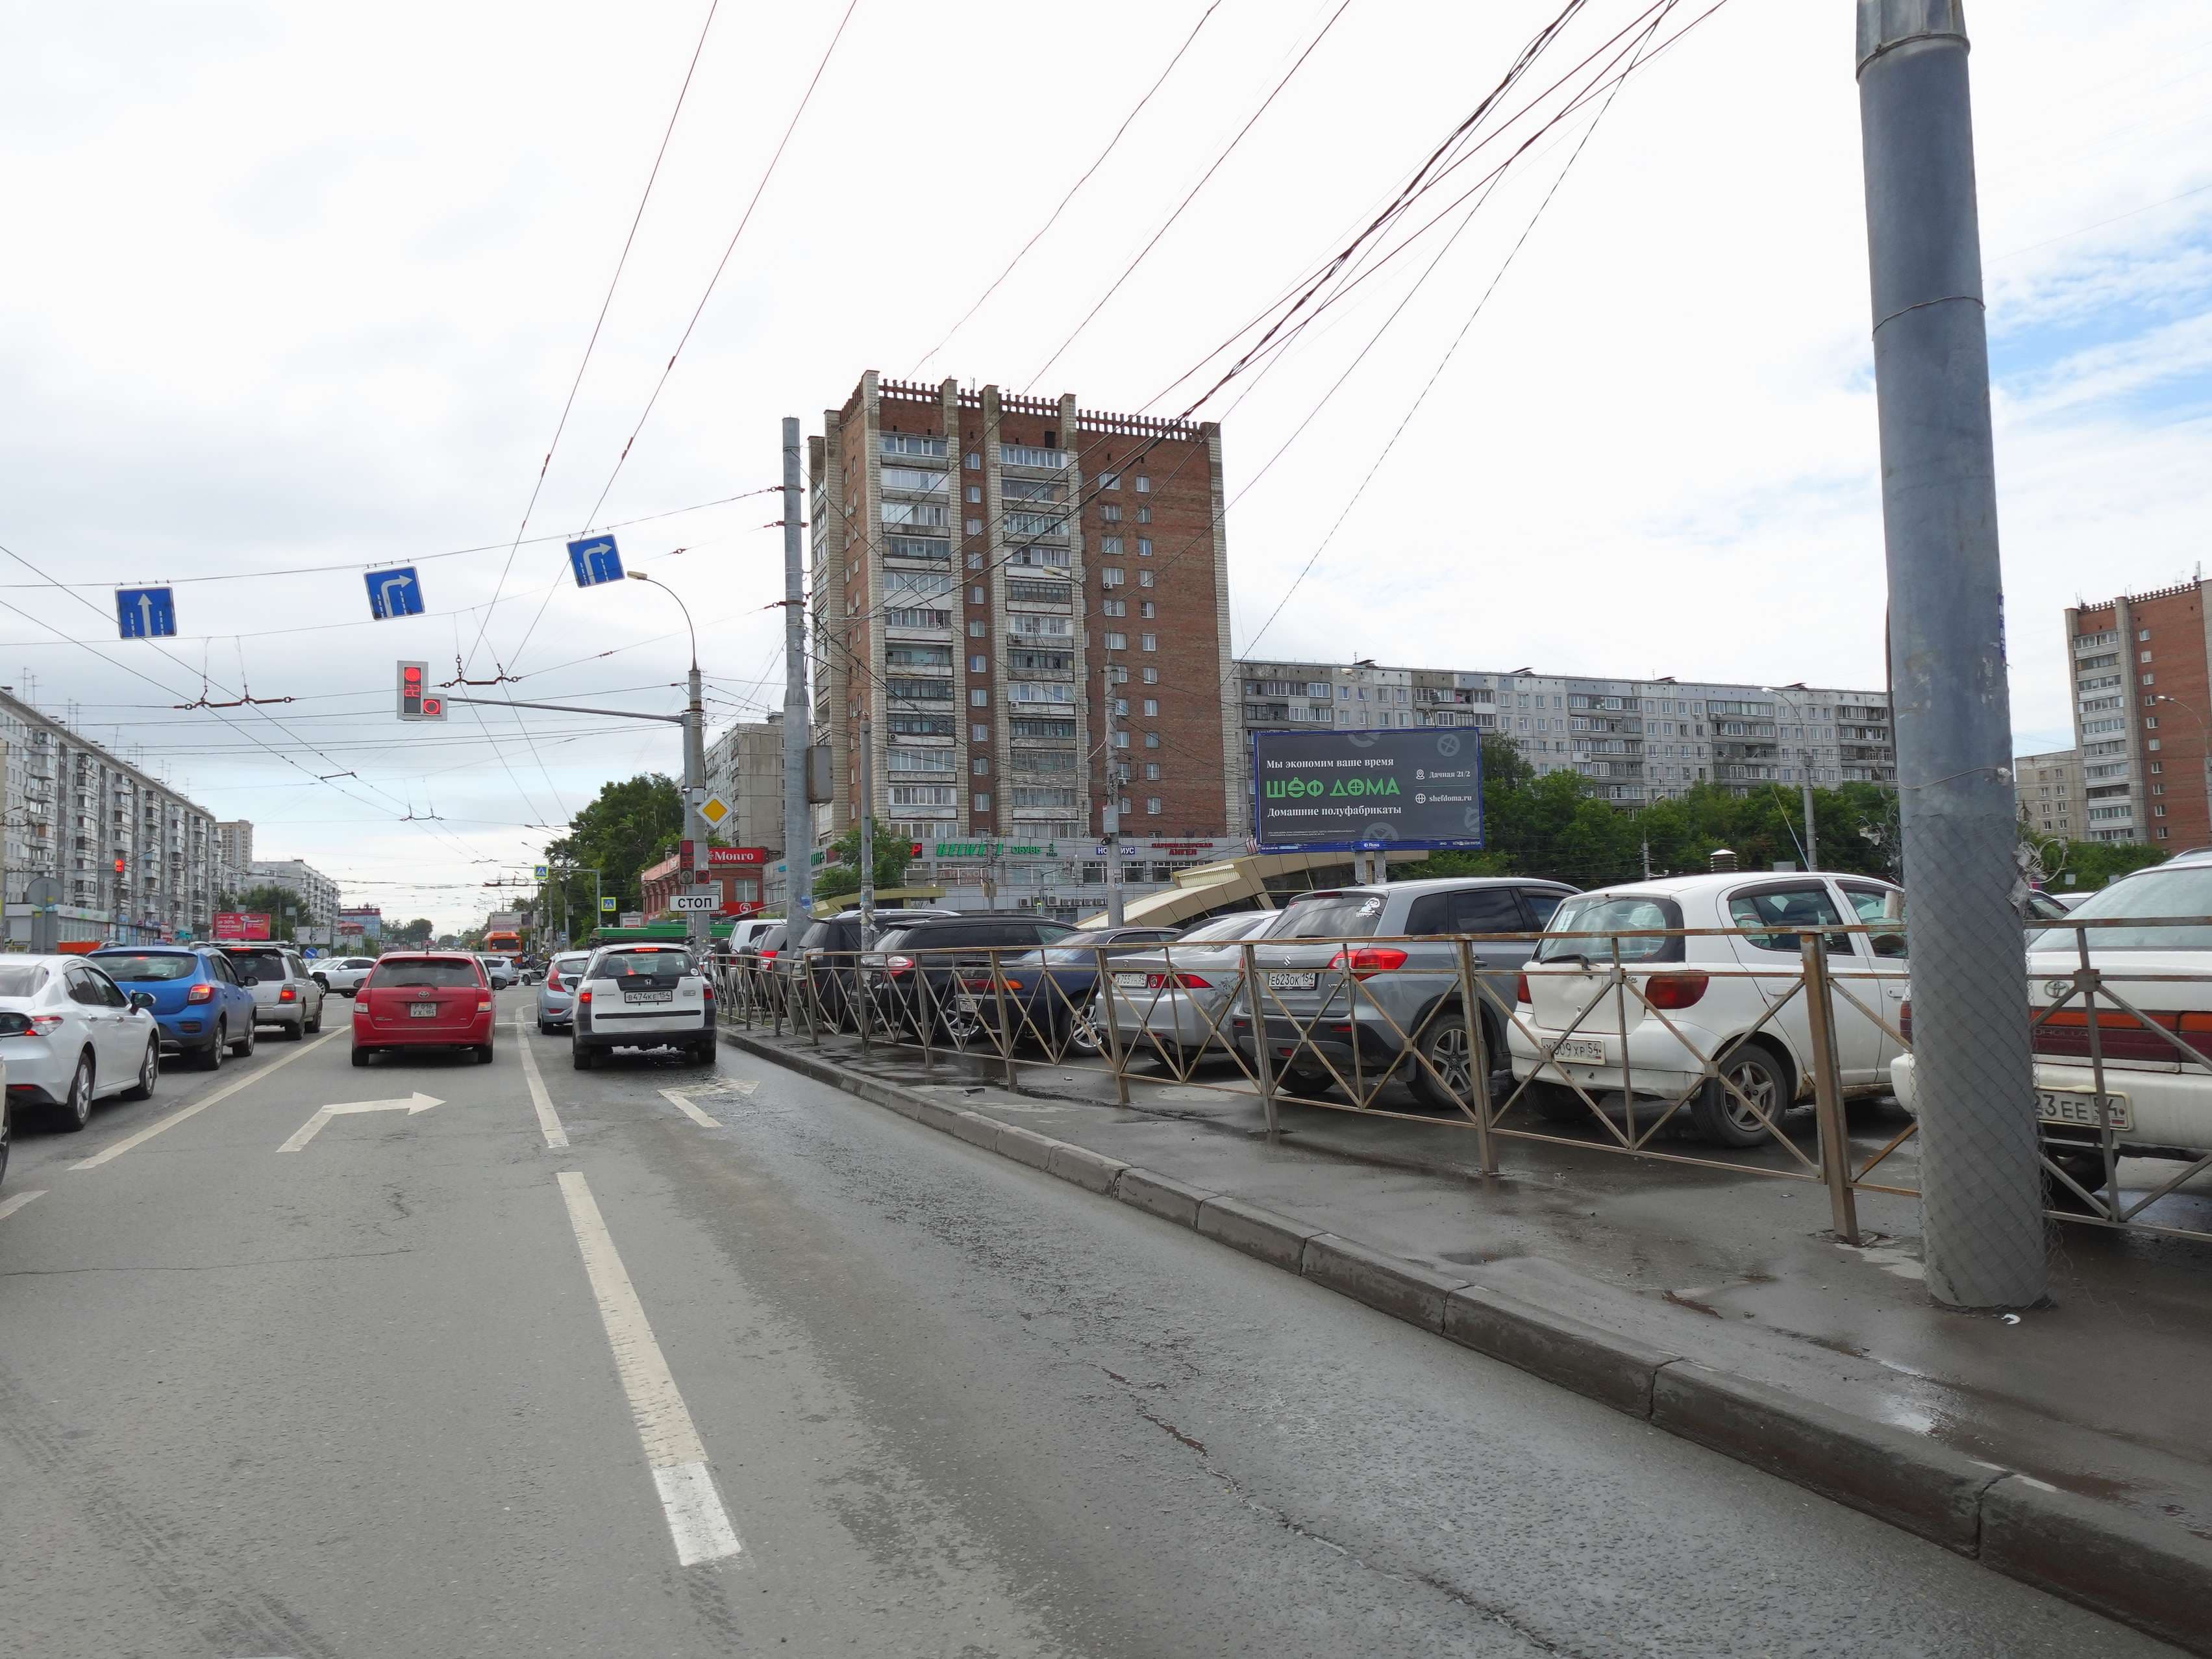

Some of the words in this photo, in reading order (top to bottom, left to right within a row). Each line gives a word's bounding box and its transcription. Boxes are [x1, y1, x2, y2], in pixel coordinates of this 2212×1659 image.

[1267, 760, 1283, 769] Мы
[1286, 759, 1334, 769] экономим
[1337, 759, 1361, 767] ваше
[1365, 758, 1394, 769] время
[1267, 777, 1324, 798] ШЕФ
[1330, 777, 1401, 797] ДОМА
[1267, 808, 1319, 817] Домашние
[1322, 806, 1402, 817] полуфабрикаты
[715, 852, 754, 860] Monro
[678, 898, 712, 908] СТОП
[1271, 974, 1300, 985] Е623ОК
[628, 993, 657, 1001] В474КЕ
